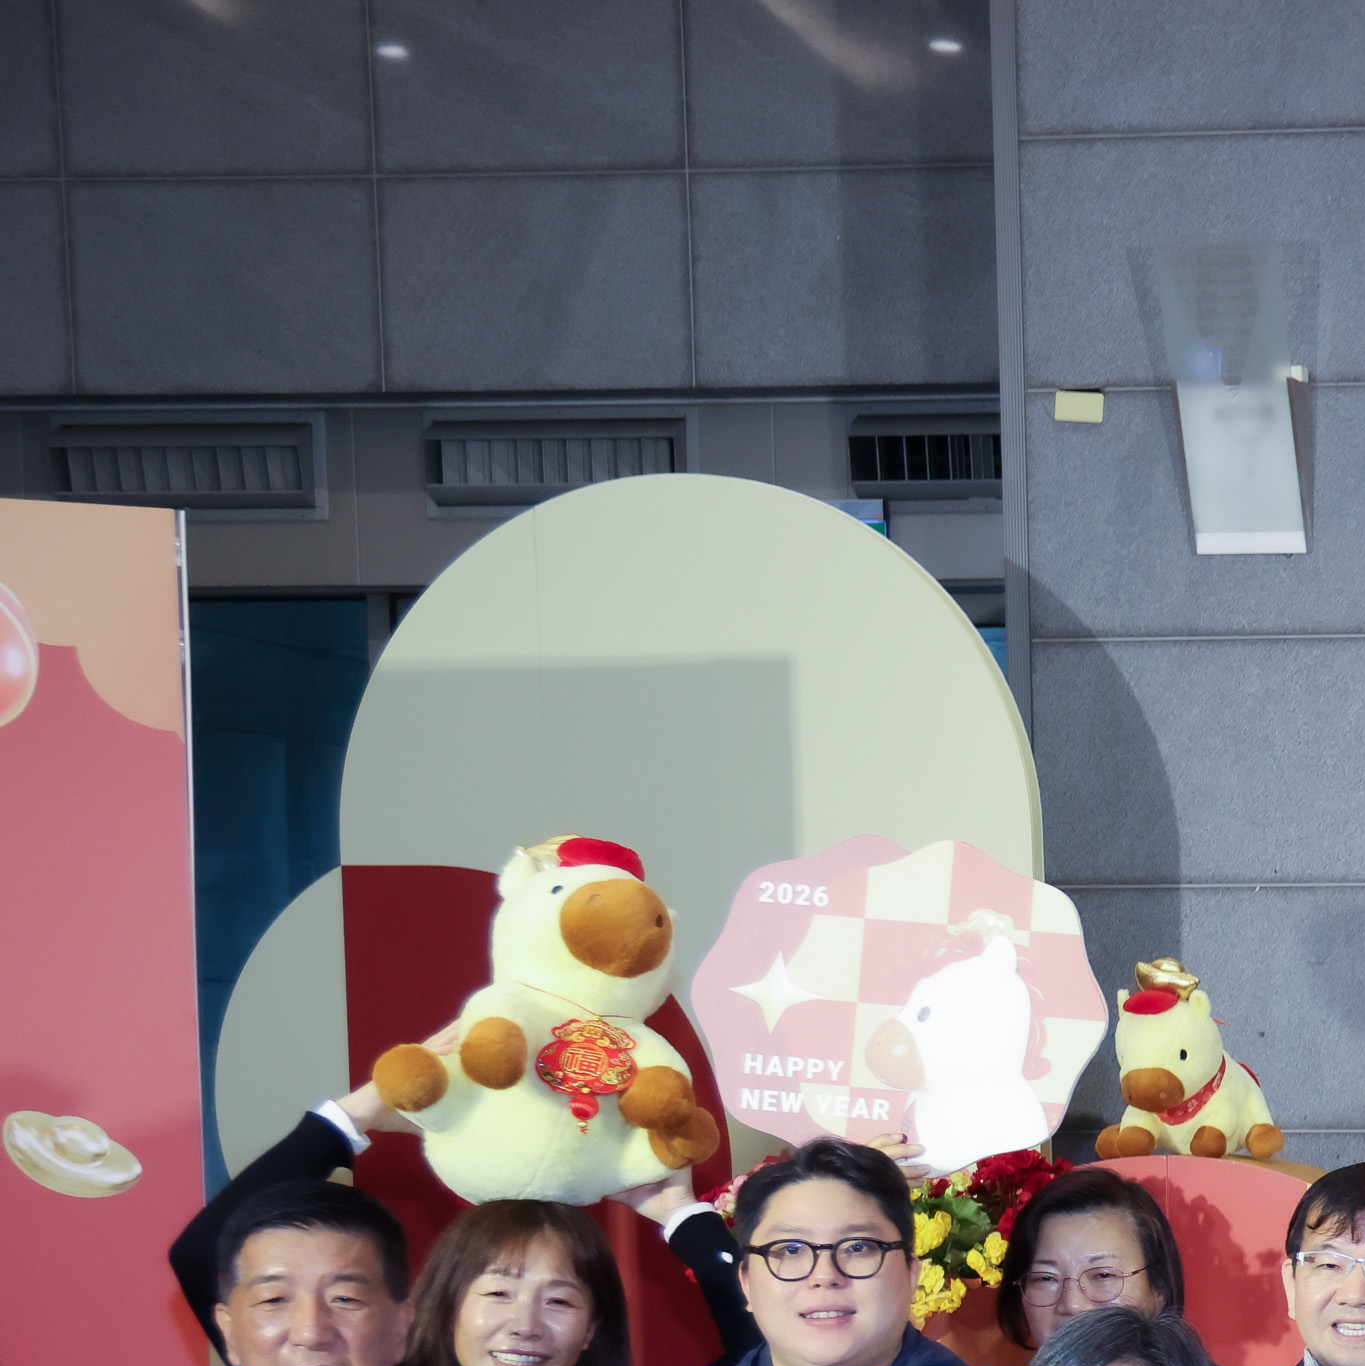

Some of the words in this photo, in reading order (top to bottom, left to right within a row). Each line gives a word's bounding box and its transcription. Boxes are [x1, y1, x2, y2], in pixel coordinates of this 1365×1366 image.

[758, 881, 830, 908] 2026
[743, 1052, 846, 1082] HAPPY
[740, 1088, 804, 1114] NEW
[815, 1094, 891, 1122] YEAR
